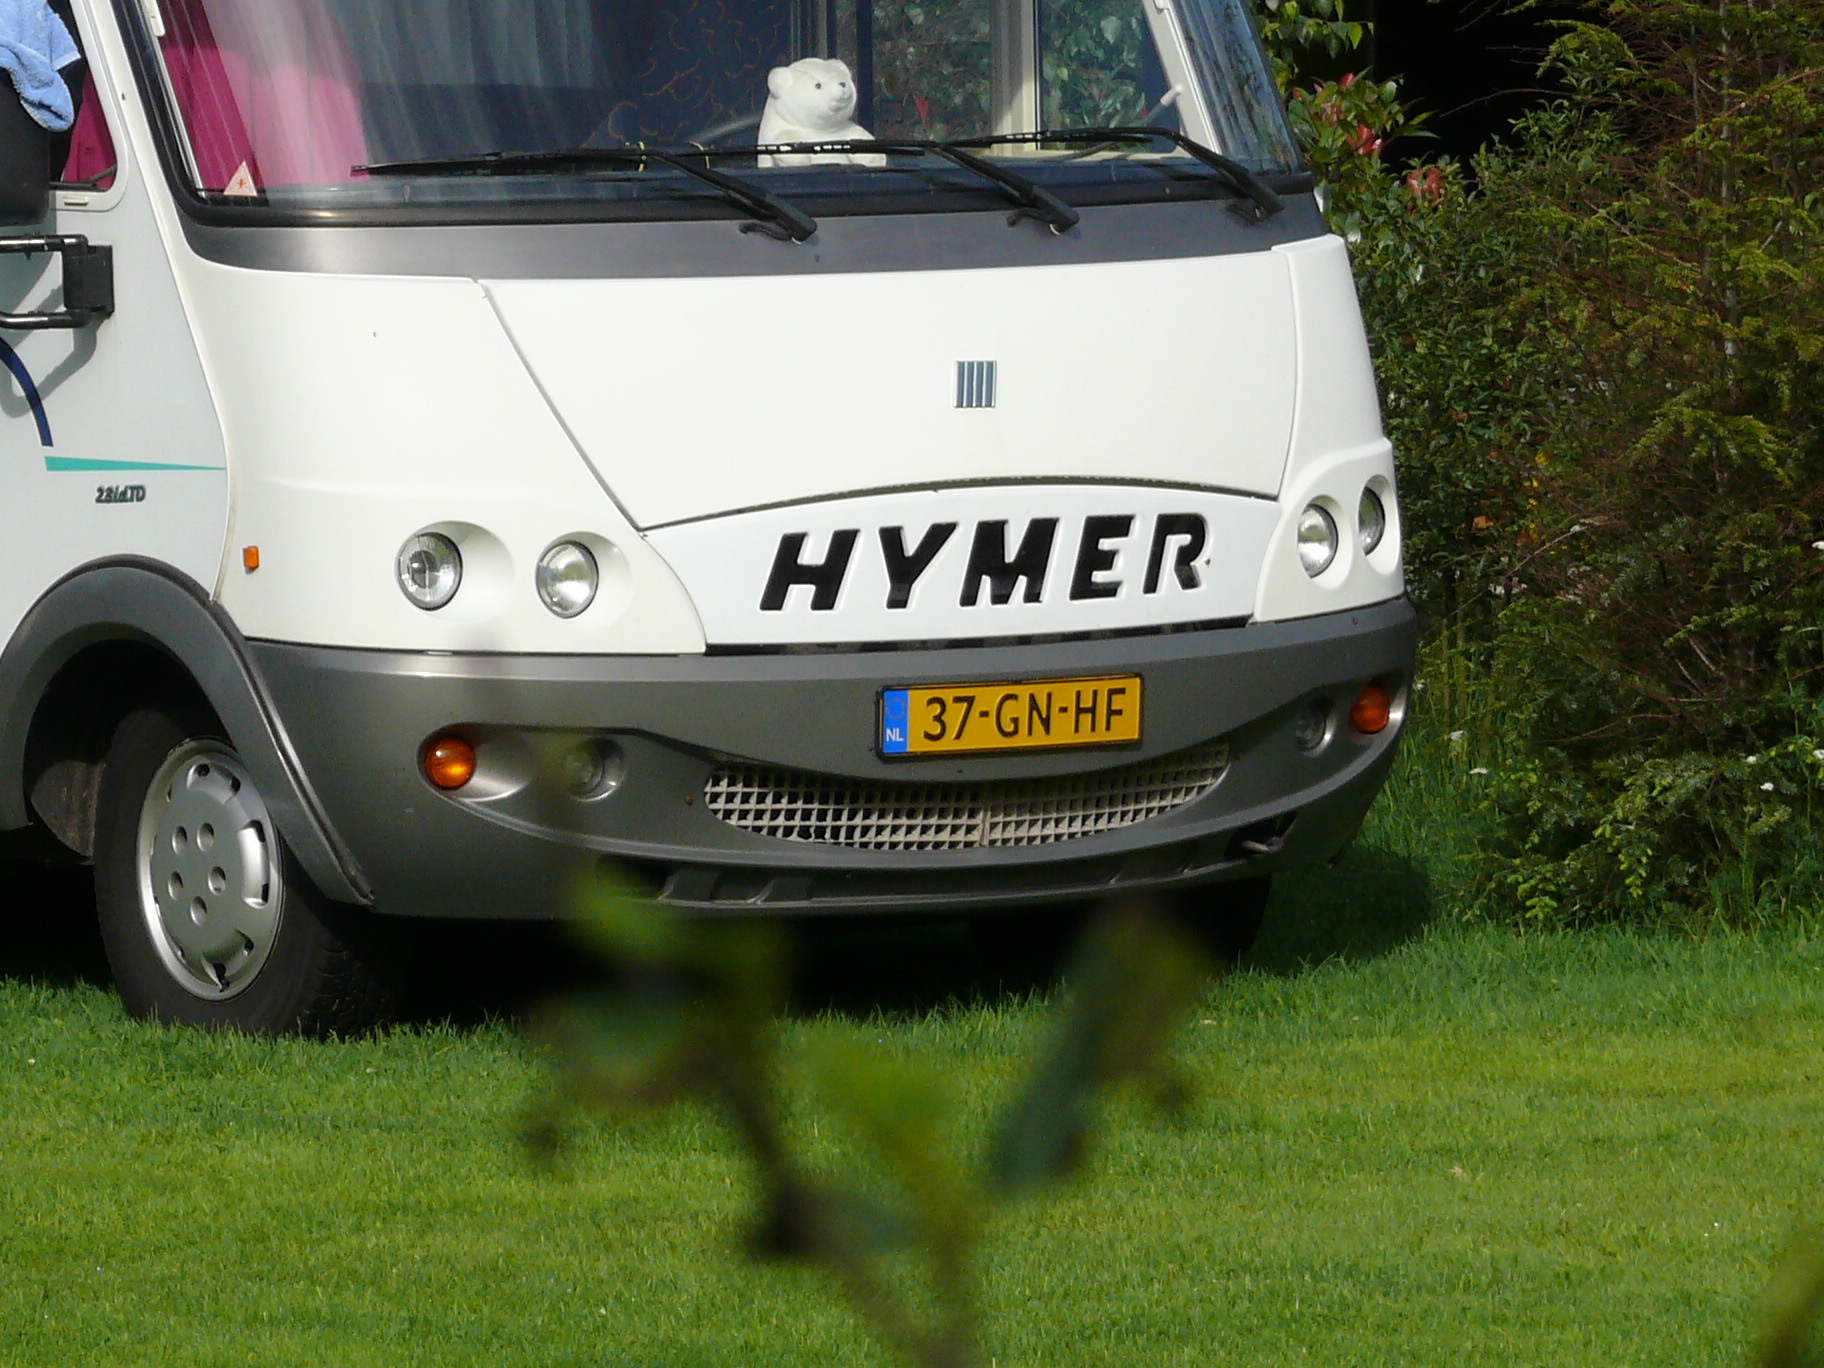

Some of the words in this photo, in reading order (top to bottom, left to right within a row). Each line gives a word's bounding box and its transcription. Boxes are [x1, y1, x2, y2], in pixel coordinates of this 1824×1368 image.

[759, 513, 1210, 611] HYMER
[885, 728, 904, 742] NL
[922, 687, 1127, 742] 37-GN-HF
